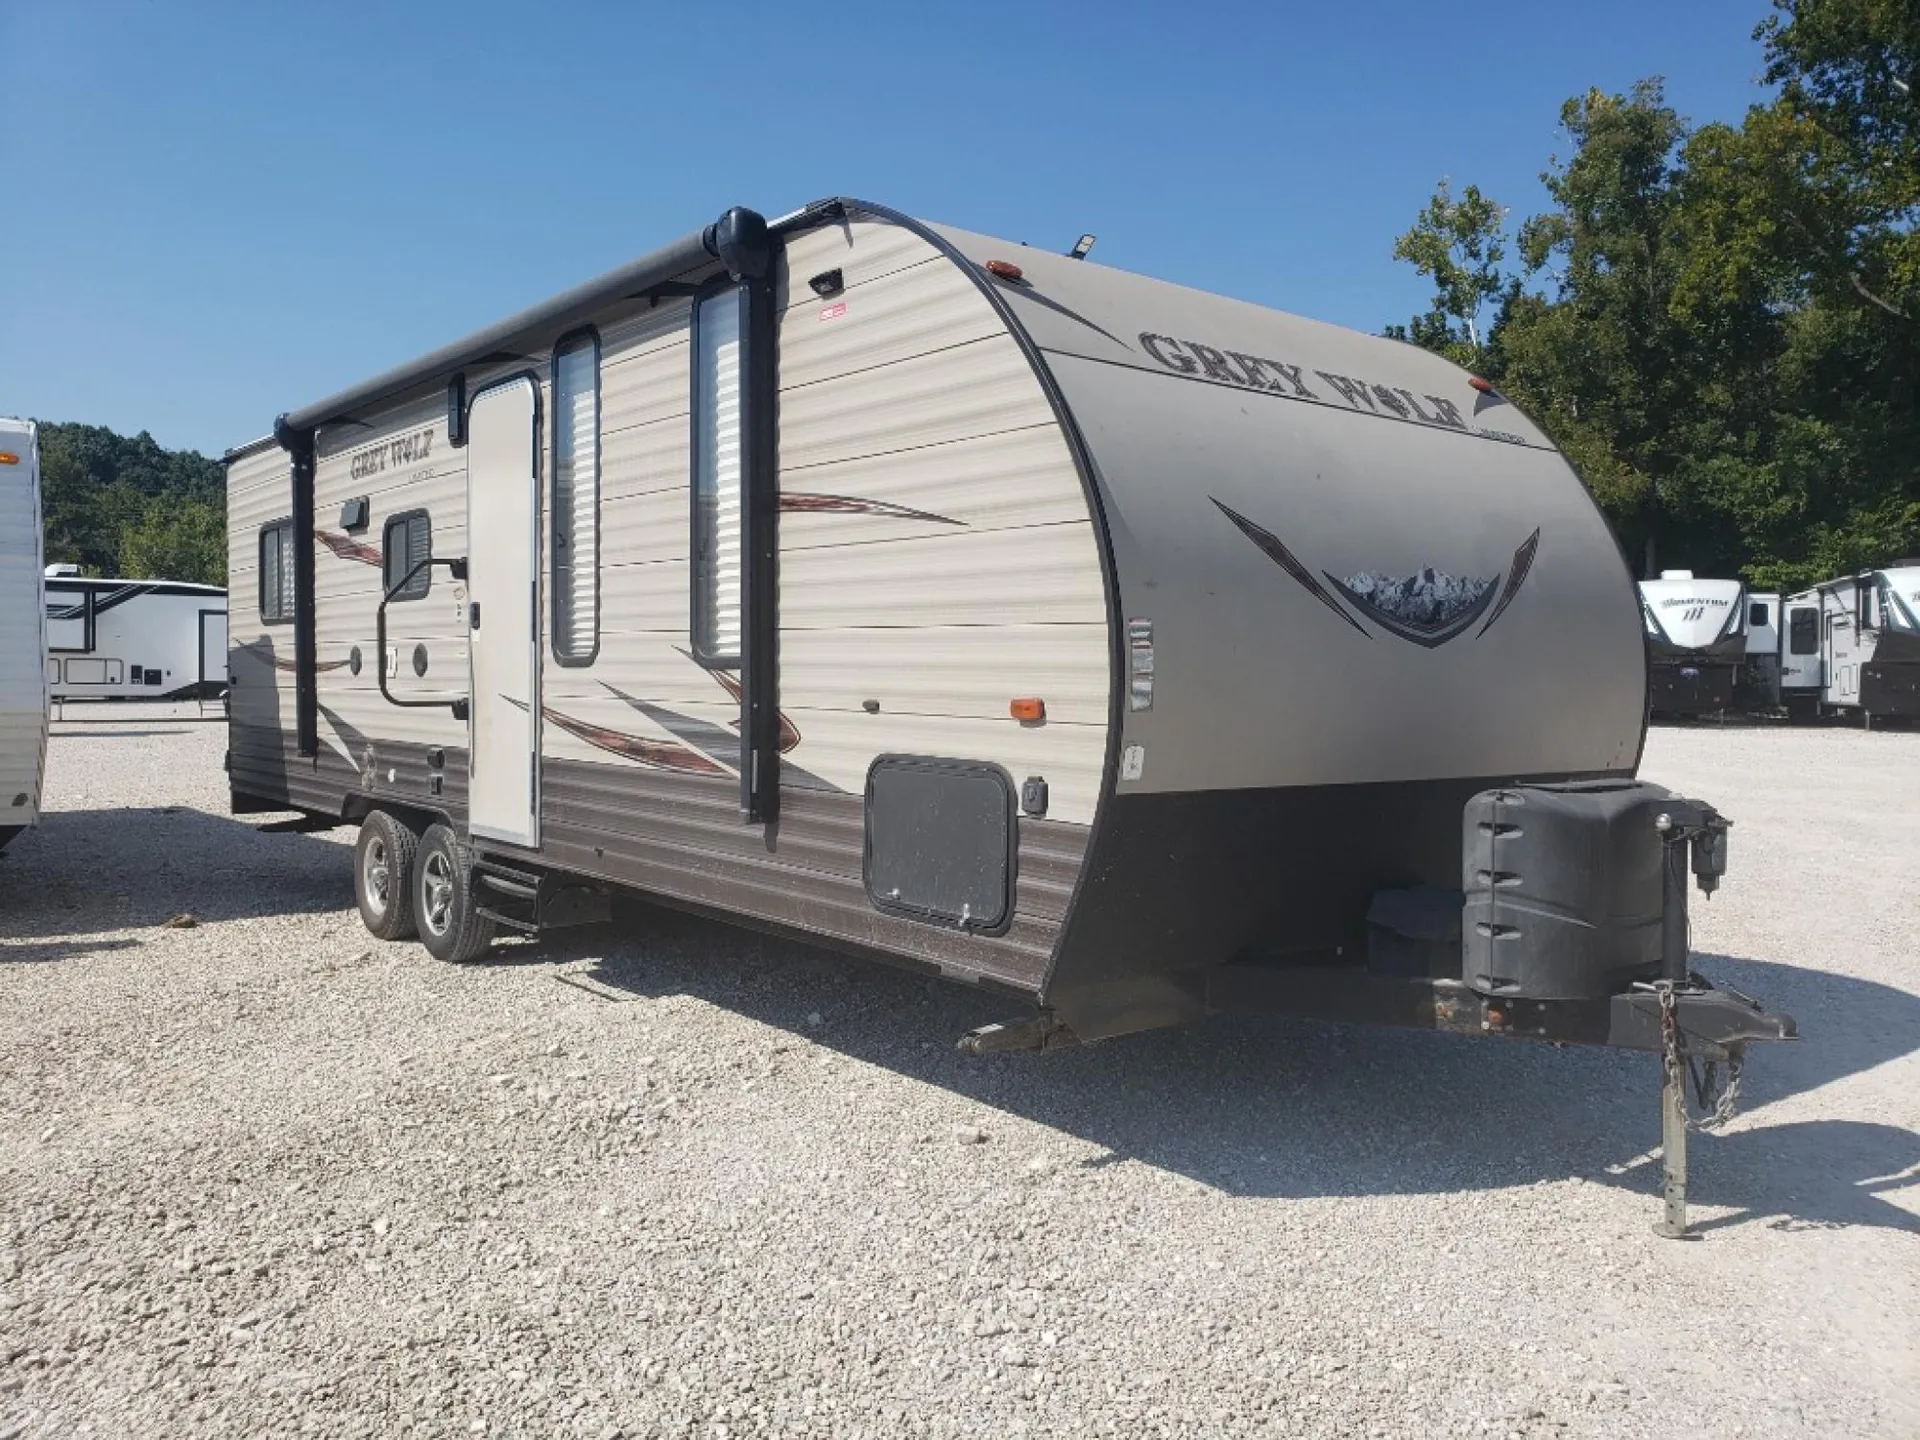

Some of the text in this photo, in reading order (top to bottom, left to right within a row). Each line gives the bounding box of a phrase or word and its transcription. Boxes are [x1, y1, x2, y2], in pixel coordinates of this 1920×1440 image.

[1138, 331, 1468, 431] GREY WOLF
[351, 444, 388, 480] GREY
